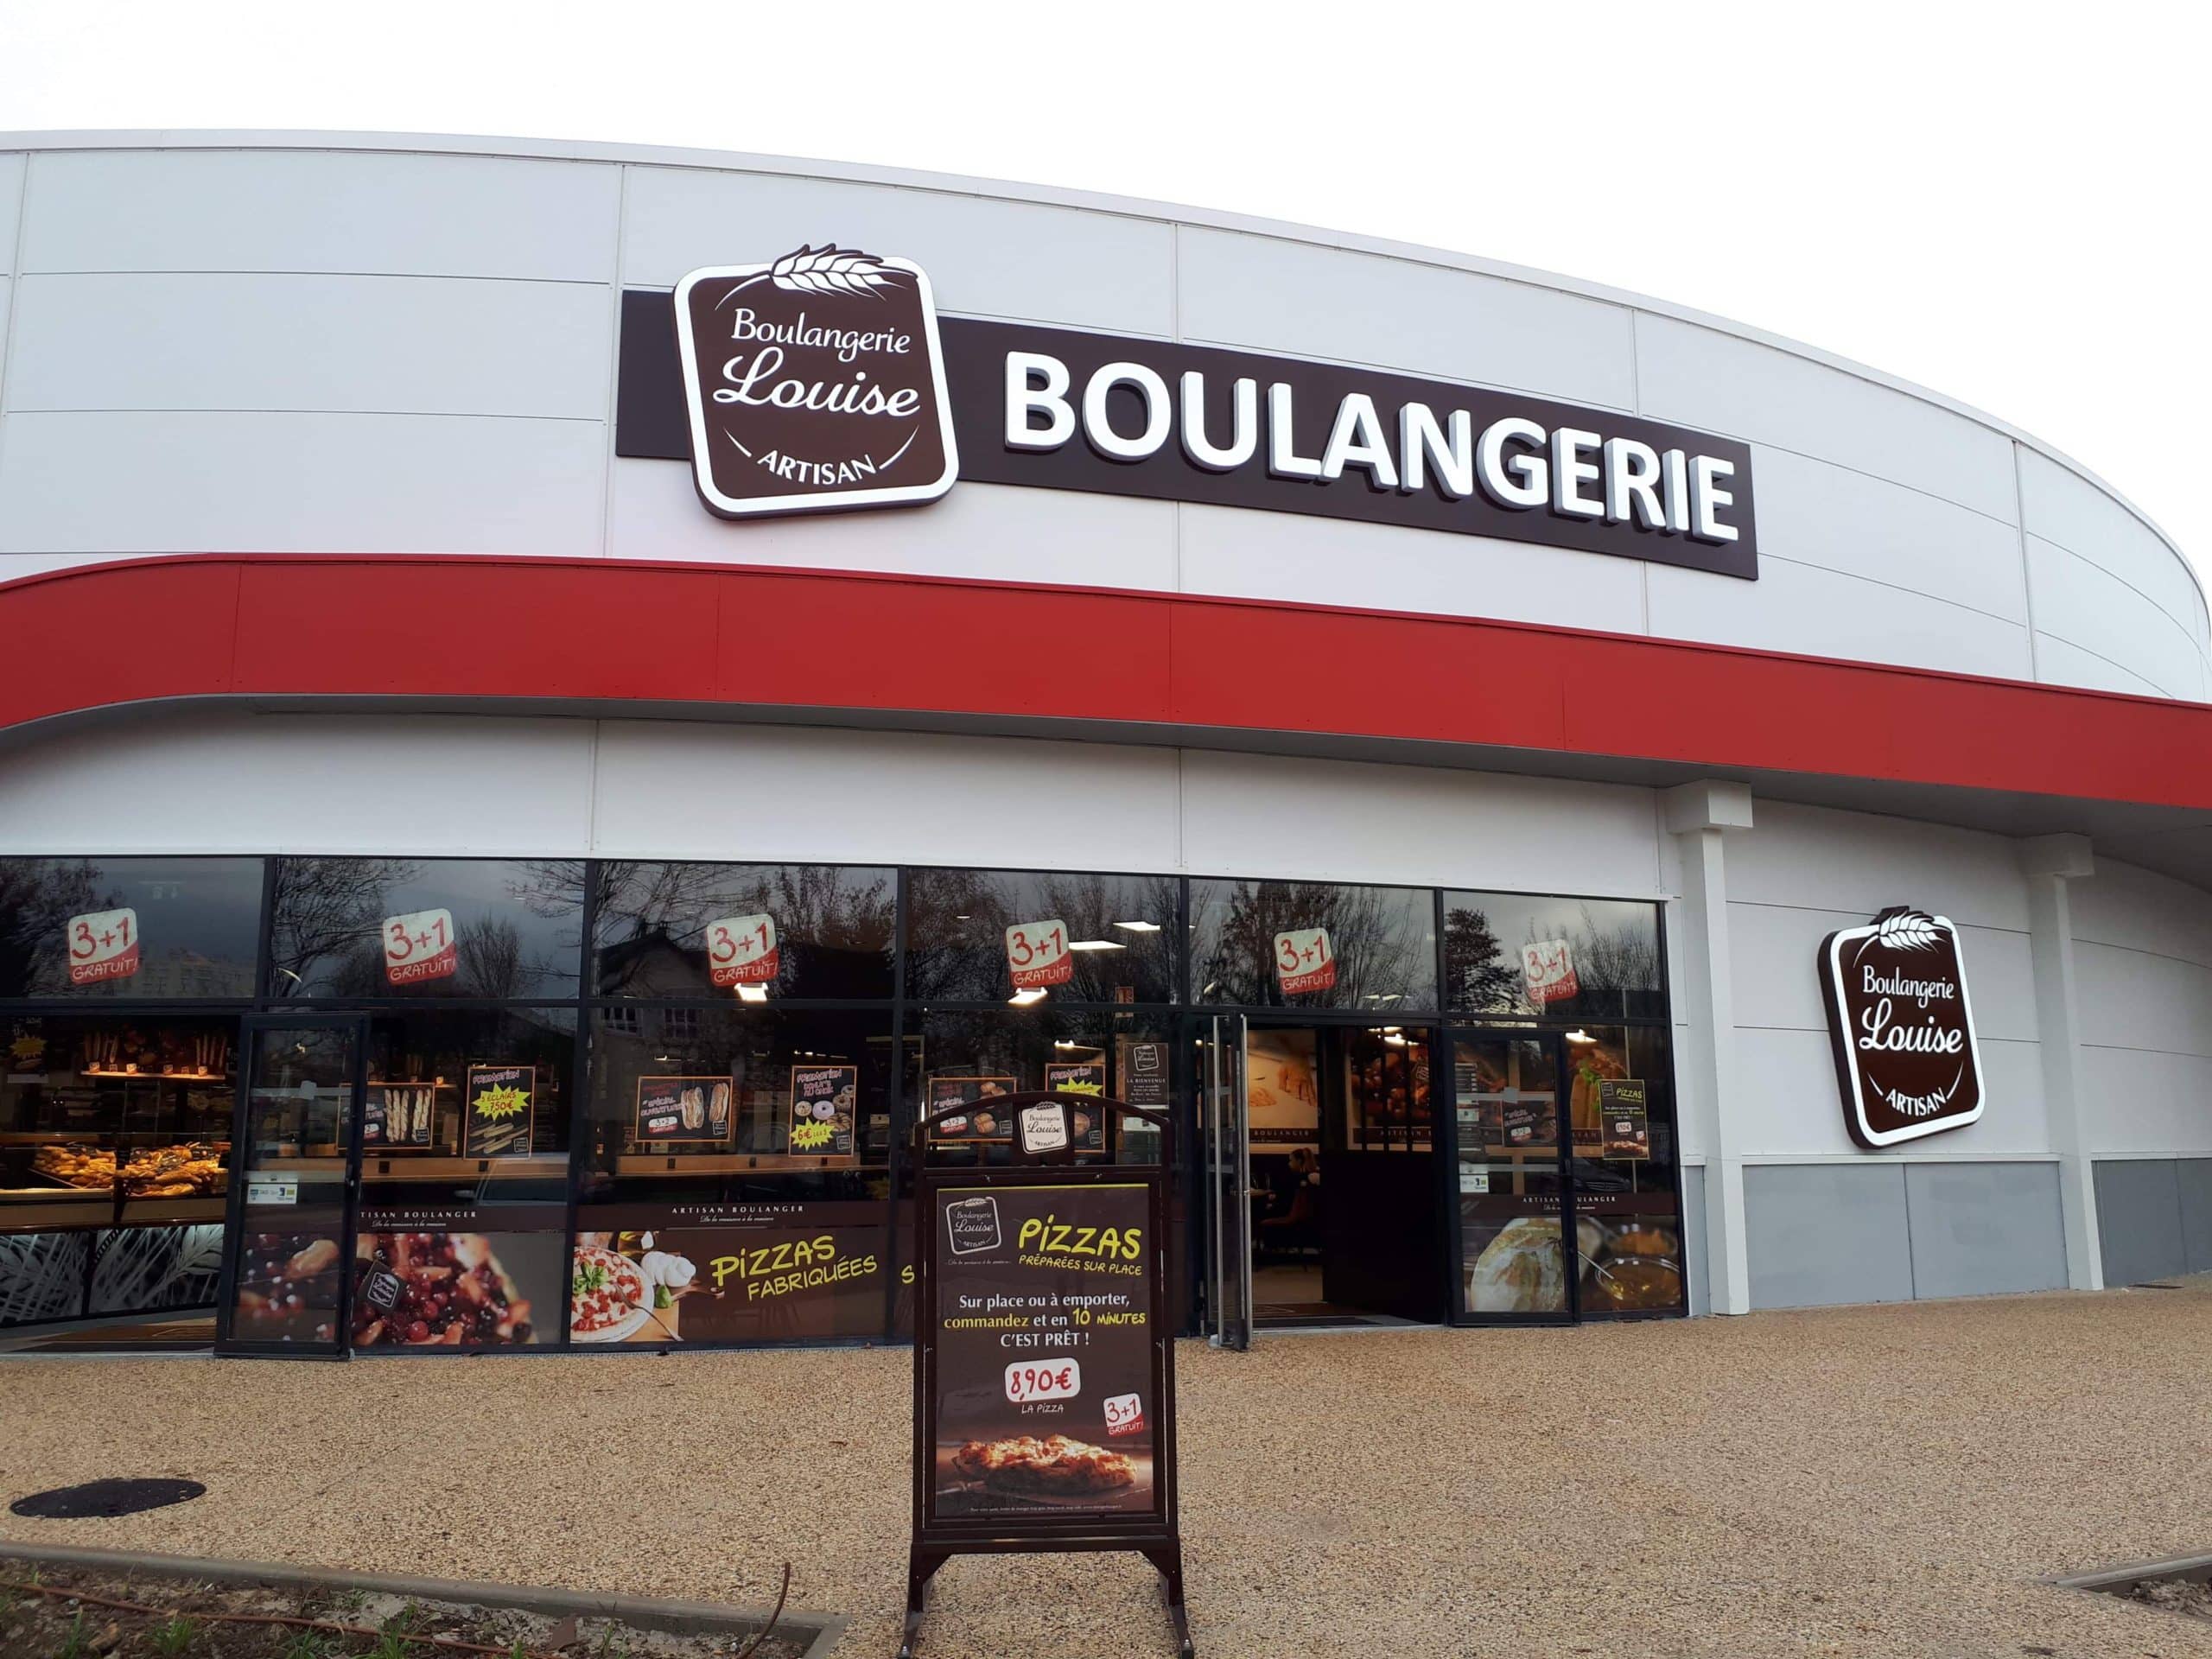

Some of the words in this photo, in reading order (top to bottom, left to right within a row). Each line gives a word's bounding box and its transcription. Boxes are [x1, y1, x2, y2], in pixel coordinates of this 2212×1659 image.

[730, 308, 912, 363] Boulangerie
[712, 346, 921, 417] Louise
[1004, 350, 1739, 544] BOULANGERIE
[756, 448, 877, 486] ARTISAN
[72, 917, 129, 959] 3+1
[388, 917, 444, 960] 3+1
[712, 922, 768, 963] 3+1
[1012, 927, 1062, 966] 3+1
[1280, 935, 1325, 972] 3+1
[1527, 947, 1567, 982] 3+1
[1863, 964, 1955, 1008] Boulangerie
[1859, 997, 1964, 1053] Louise
[1885, 1086, 1947, 1116] ARTISAN
[1026, 1121, 1063, 1133] Louise
[671, 1206, 724, 1215] ARTISAN
[732, 1205, 804, 1214] BOULANGER
[1577, 1195, 1616, 1204] ULANGER
[954, 1218, 995, 1233] Louise
[747, 1255, 878, 1302] FABRIQUÉES
[901, 1264, 916, 1285] S
[1019, 1253, 1081, 1271] PRÉPARÉES
[1084, 1260, 1107, 1274] SUR
[1109, 1262, 1142, 1276] PLACE
[944, 1313, 1029, 1329] commandez
[1033, 1314, 1046, 1327] et
[1051, 1315, 1068, 1326] en
[1072, 1307, 1091, 1326] 10
[959, 1294, 983, 1309] Sur
[987, 1294, 1024, 1312] place
[1028, 1296, 1046, 1307] ou
[1050, 1293, 1058, 1306] à
[1062, 1293, 1130, 1312] emporter,
[1000, 1332, 1040, 1348] C'EST
[1045, 1329, 1080, 1346] PRÊT
[1084, 1332, 1090, 1345] !
[1010, 1367, 1072, 1402] 8,90€
[1021, 1403, 1034, 1414] LA
[1107, 1398, 1137, 1423] 3+1
